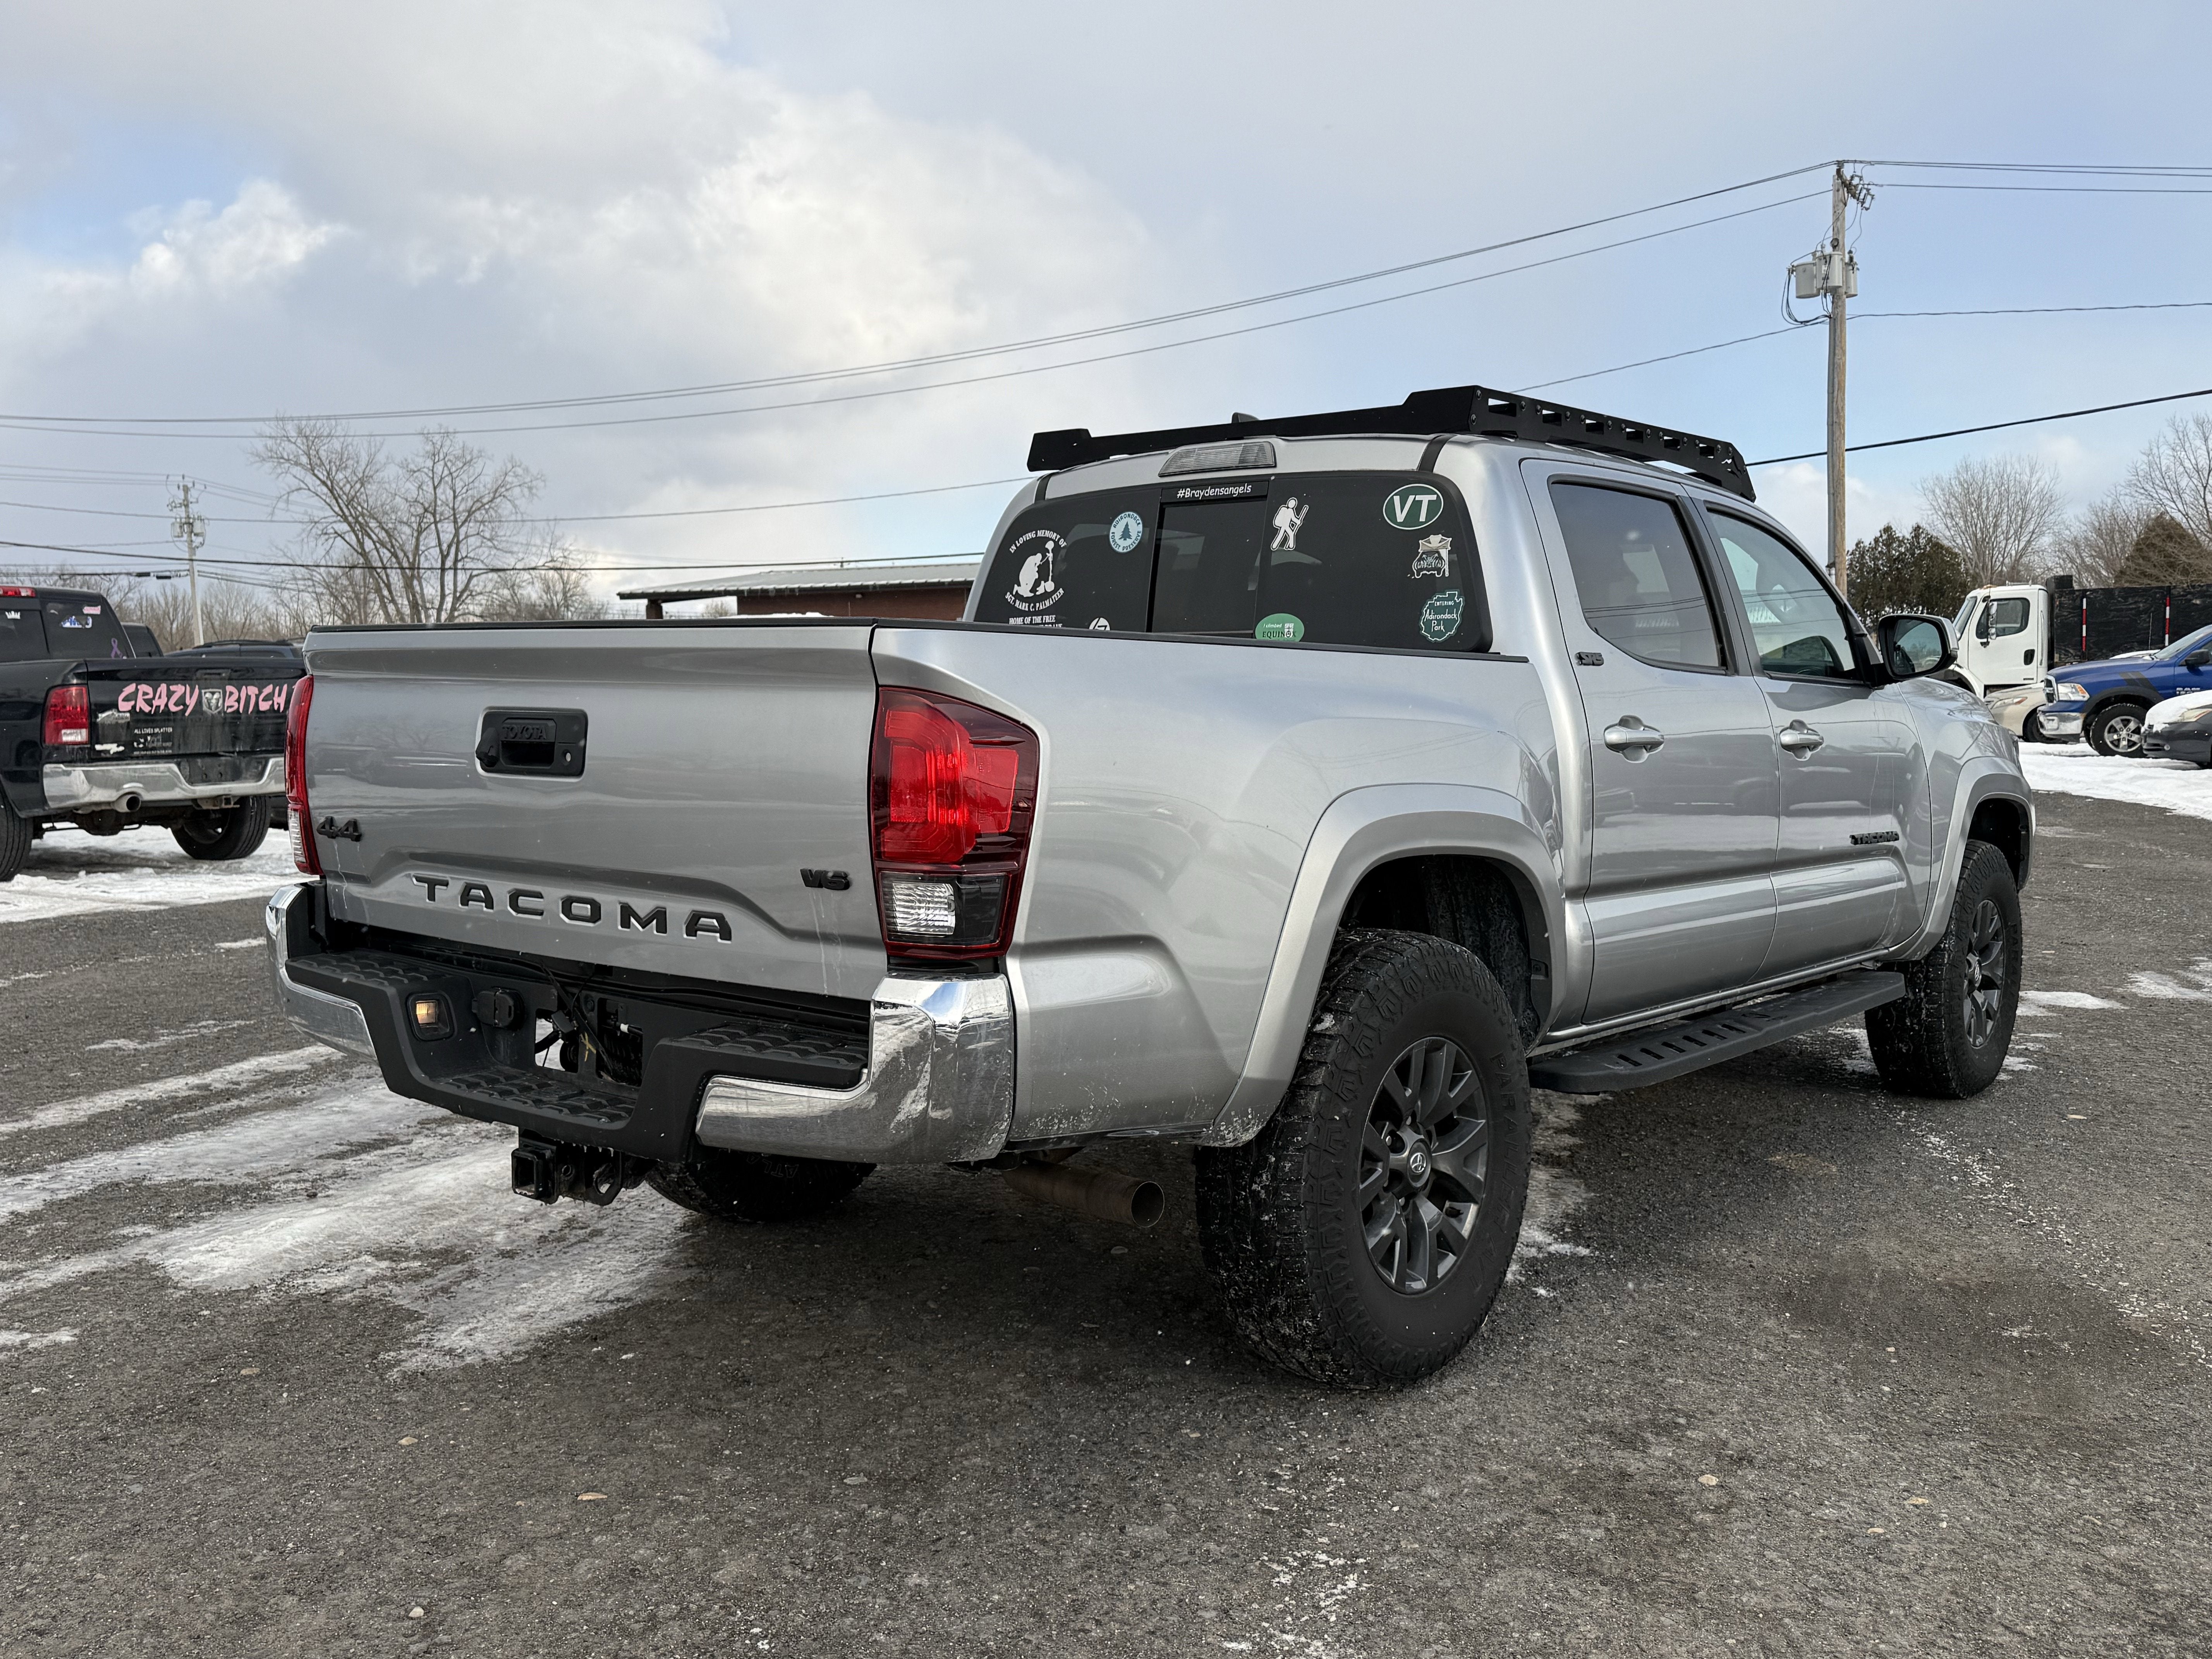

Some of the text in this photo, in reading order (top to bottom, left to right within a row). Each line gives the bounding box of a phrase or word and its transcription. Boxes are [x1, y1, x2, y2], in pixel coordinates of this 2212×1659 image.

[1177, 483, 1252, 500] #Braydensangels
[1393, 495, 1437, 522] VT
[1113, 513, 1141, 529] ADIRONDACK
[1009, 529, 1067, 553] IN LOVING MEMORY OF
[1111, 531, 1141, 551] FOREST PRESERVE
[1005, 588, 1065, 611] SGT. MARK C. PALMATEER
[1032, 616, 1042, 624] THE
[1042, 615, 1056, 623] FREE
[1424, 608, 1458, 622] Adirondack
[1262, 630, 1297, 639] EQUINOX
[1431, 620, 1445, 632] Park
[1575, 651, 1604, 666] SR5
[118, 683, 287, 716] CRAZY BITCH
[502, 724, 548, 740] TOYOTA
[1849, 831, 1899, 845] TACOMA
[800, 868, 850, 891] V6
[412, 874, 733, 943] TACOMA
[746, 1152, 799, 1178] ATLA
